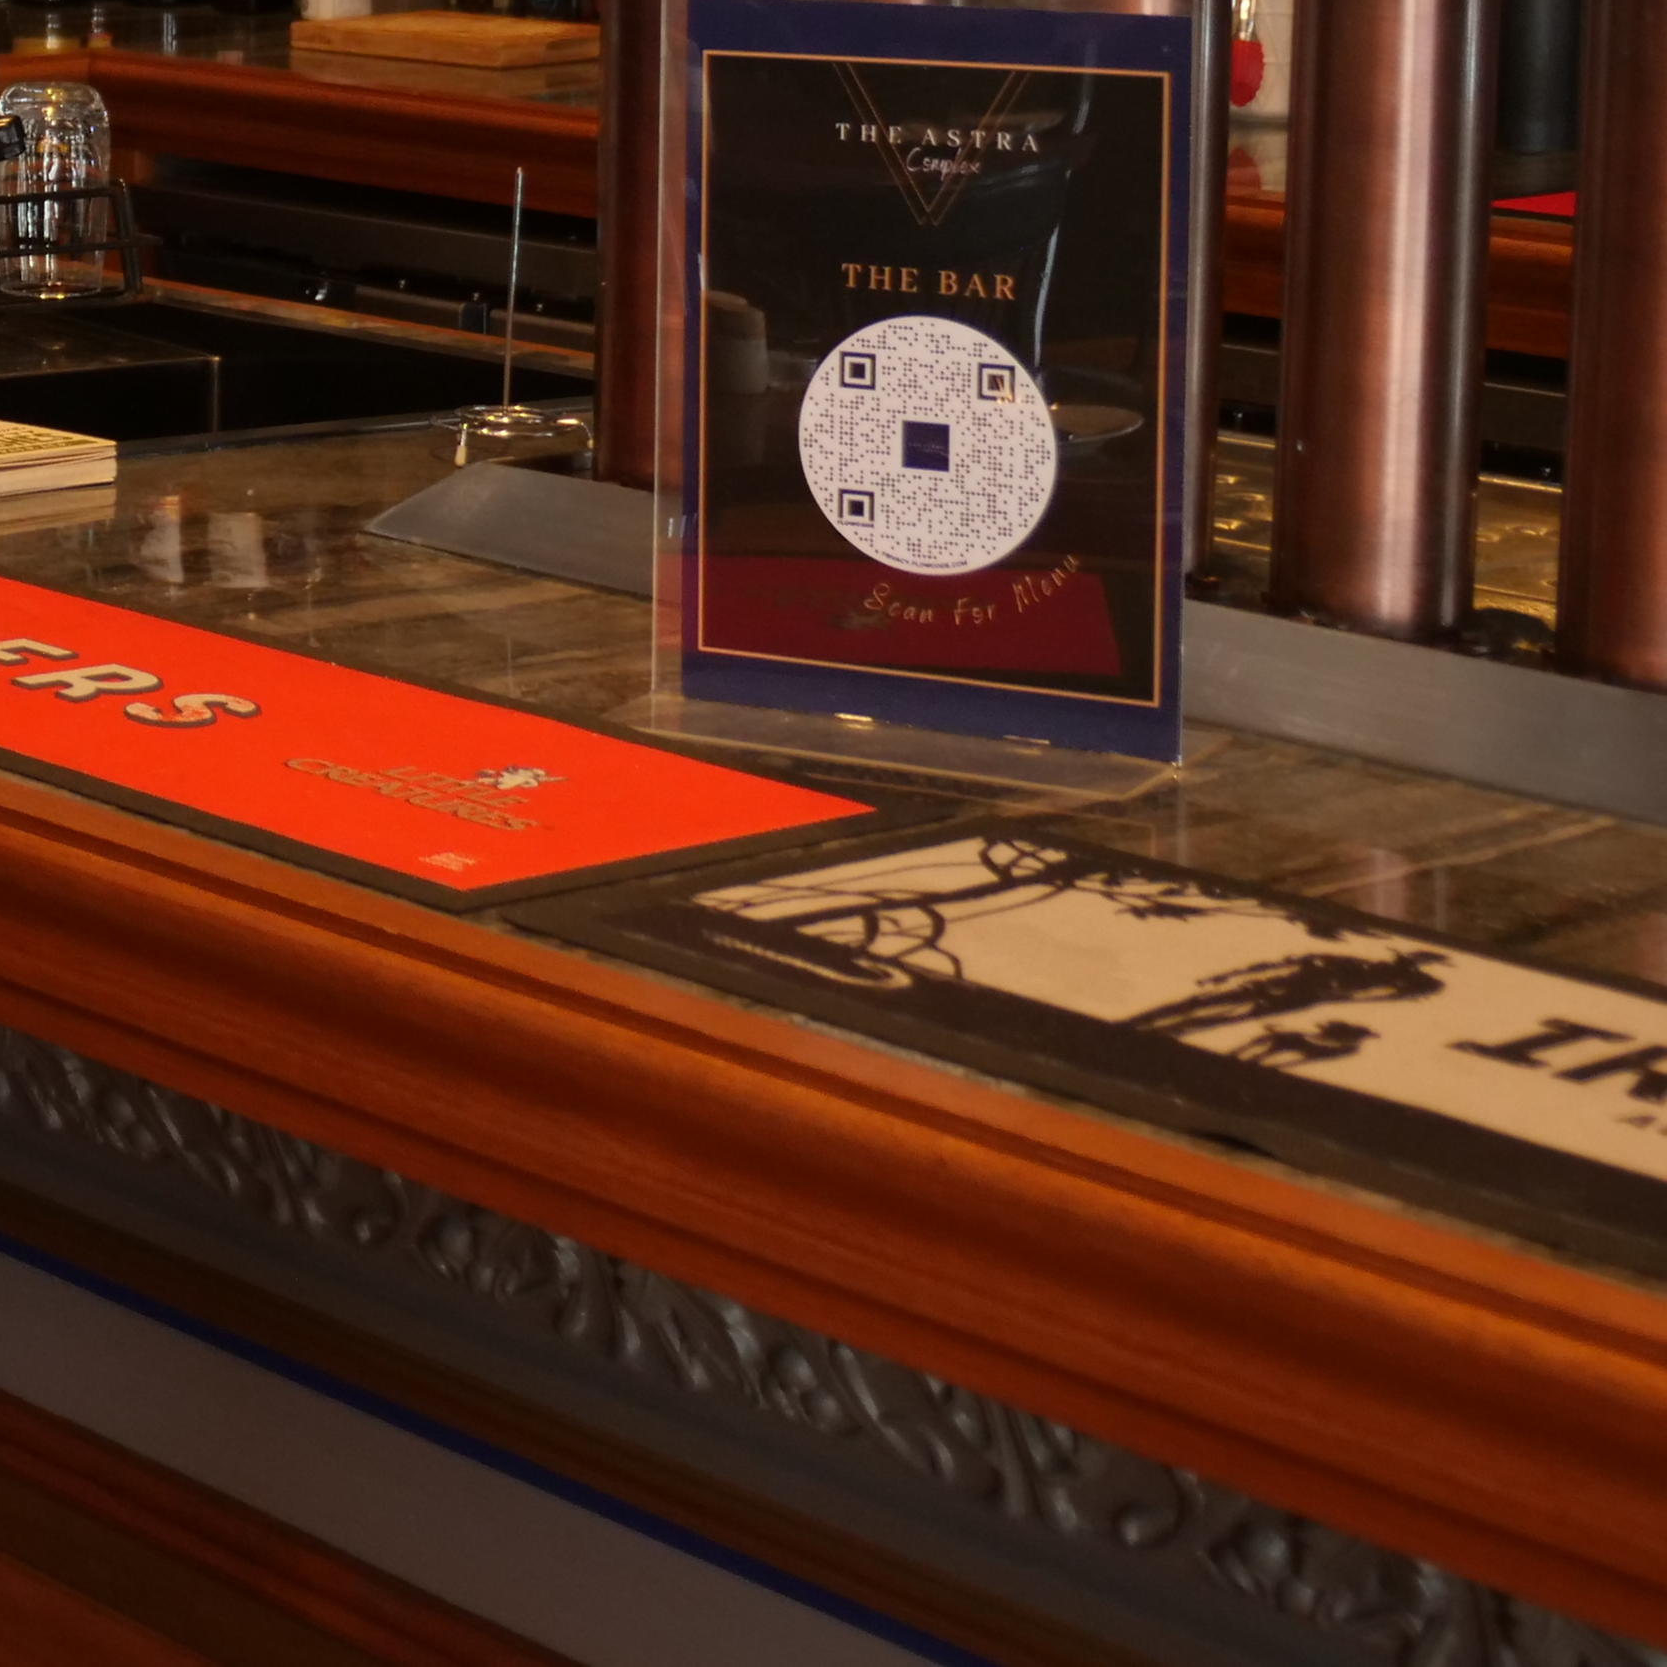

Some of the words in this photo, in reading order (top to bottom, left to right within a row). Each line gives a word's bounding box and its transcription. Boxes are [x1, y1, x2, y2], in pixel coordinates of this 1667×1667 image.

[835, 122, 903, 145] THE
[921, 128, 1039, 153] ASTRA
[841, 262, 919, 294] THE
[937, 269, 1017, 301] BAR
[863, 582, 934, 625] Scan
[1011, 554, 1081, 614] Menu
[283, 758, 539, 831] CREATURES
